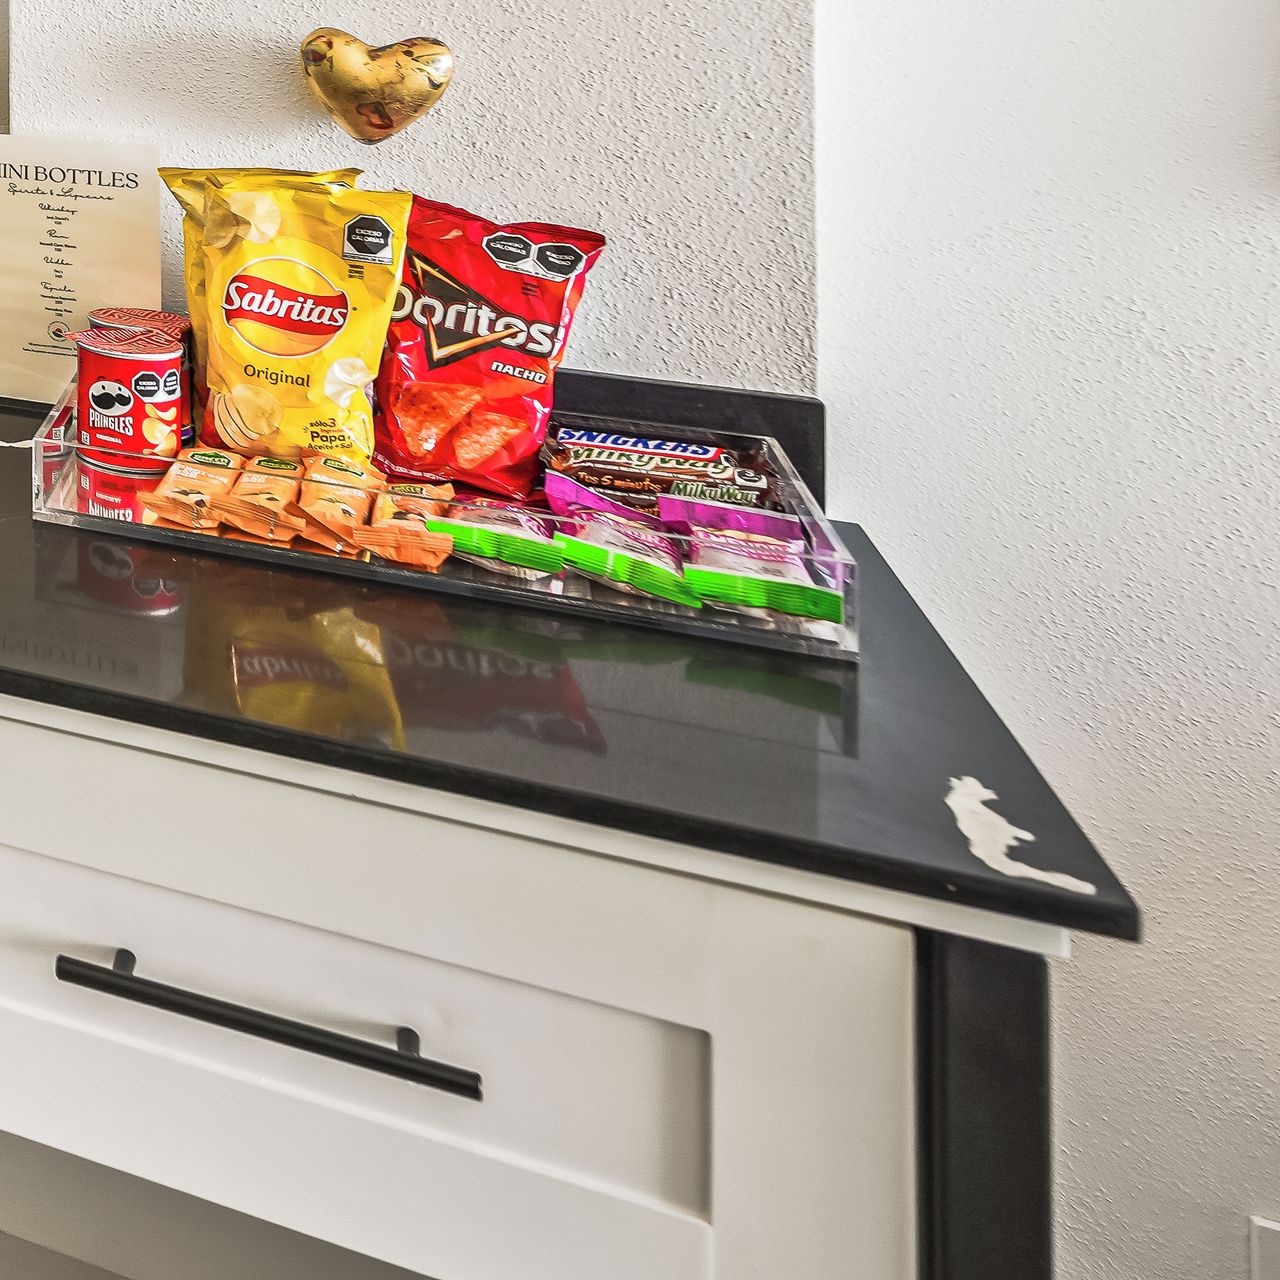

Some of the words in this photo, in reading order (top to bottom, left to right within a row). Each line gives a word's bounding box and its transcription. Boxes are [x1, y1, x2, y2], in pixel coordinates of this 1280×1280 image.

[34, 166, 139, 189] BOTTLES
[221, 282, 348, 326] Sabritas
[244, 364, 311, 388] Original
[491, 361, 547, 383] NACHO
[89, 409, 134, 437] PRINGLES
[310, 430, 346, 445] Papa
[559, 429, 710, 456] SNICKERS
